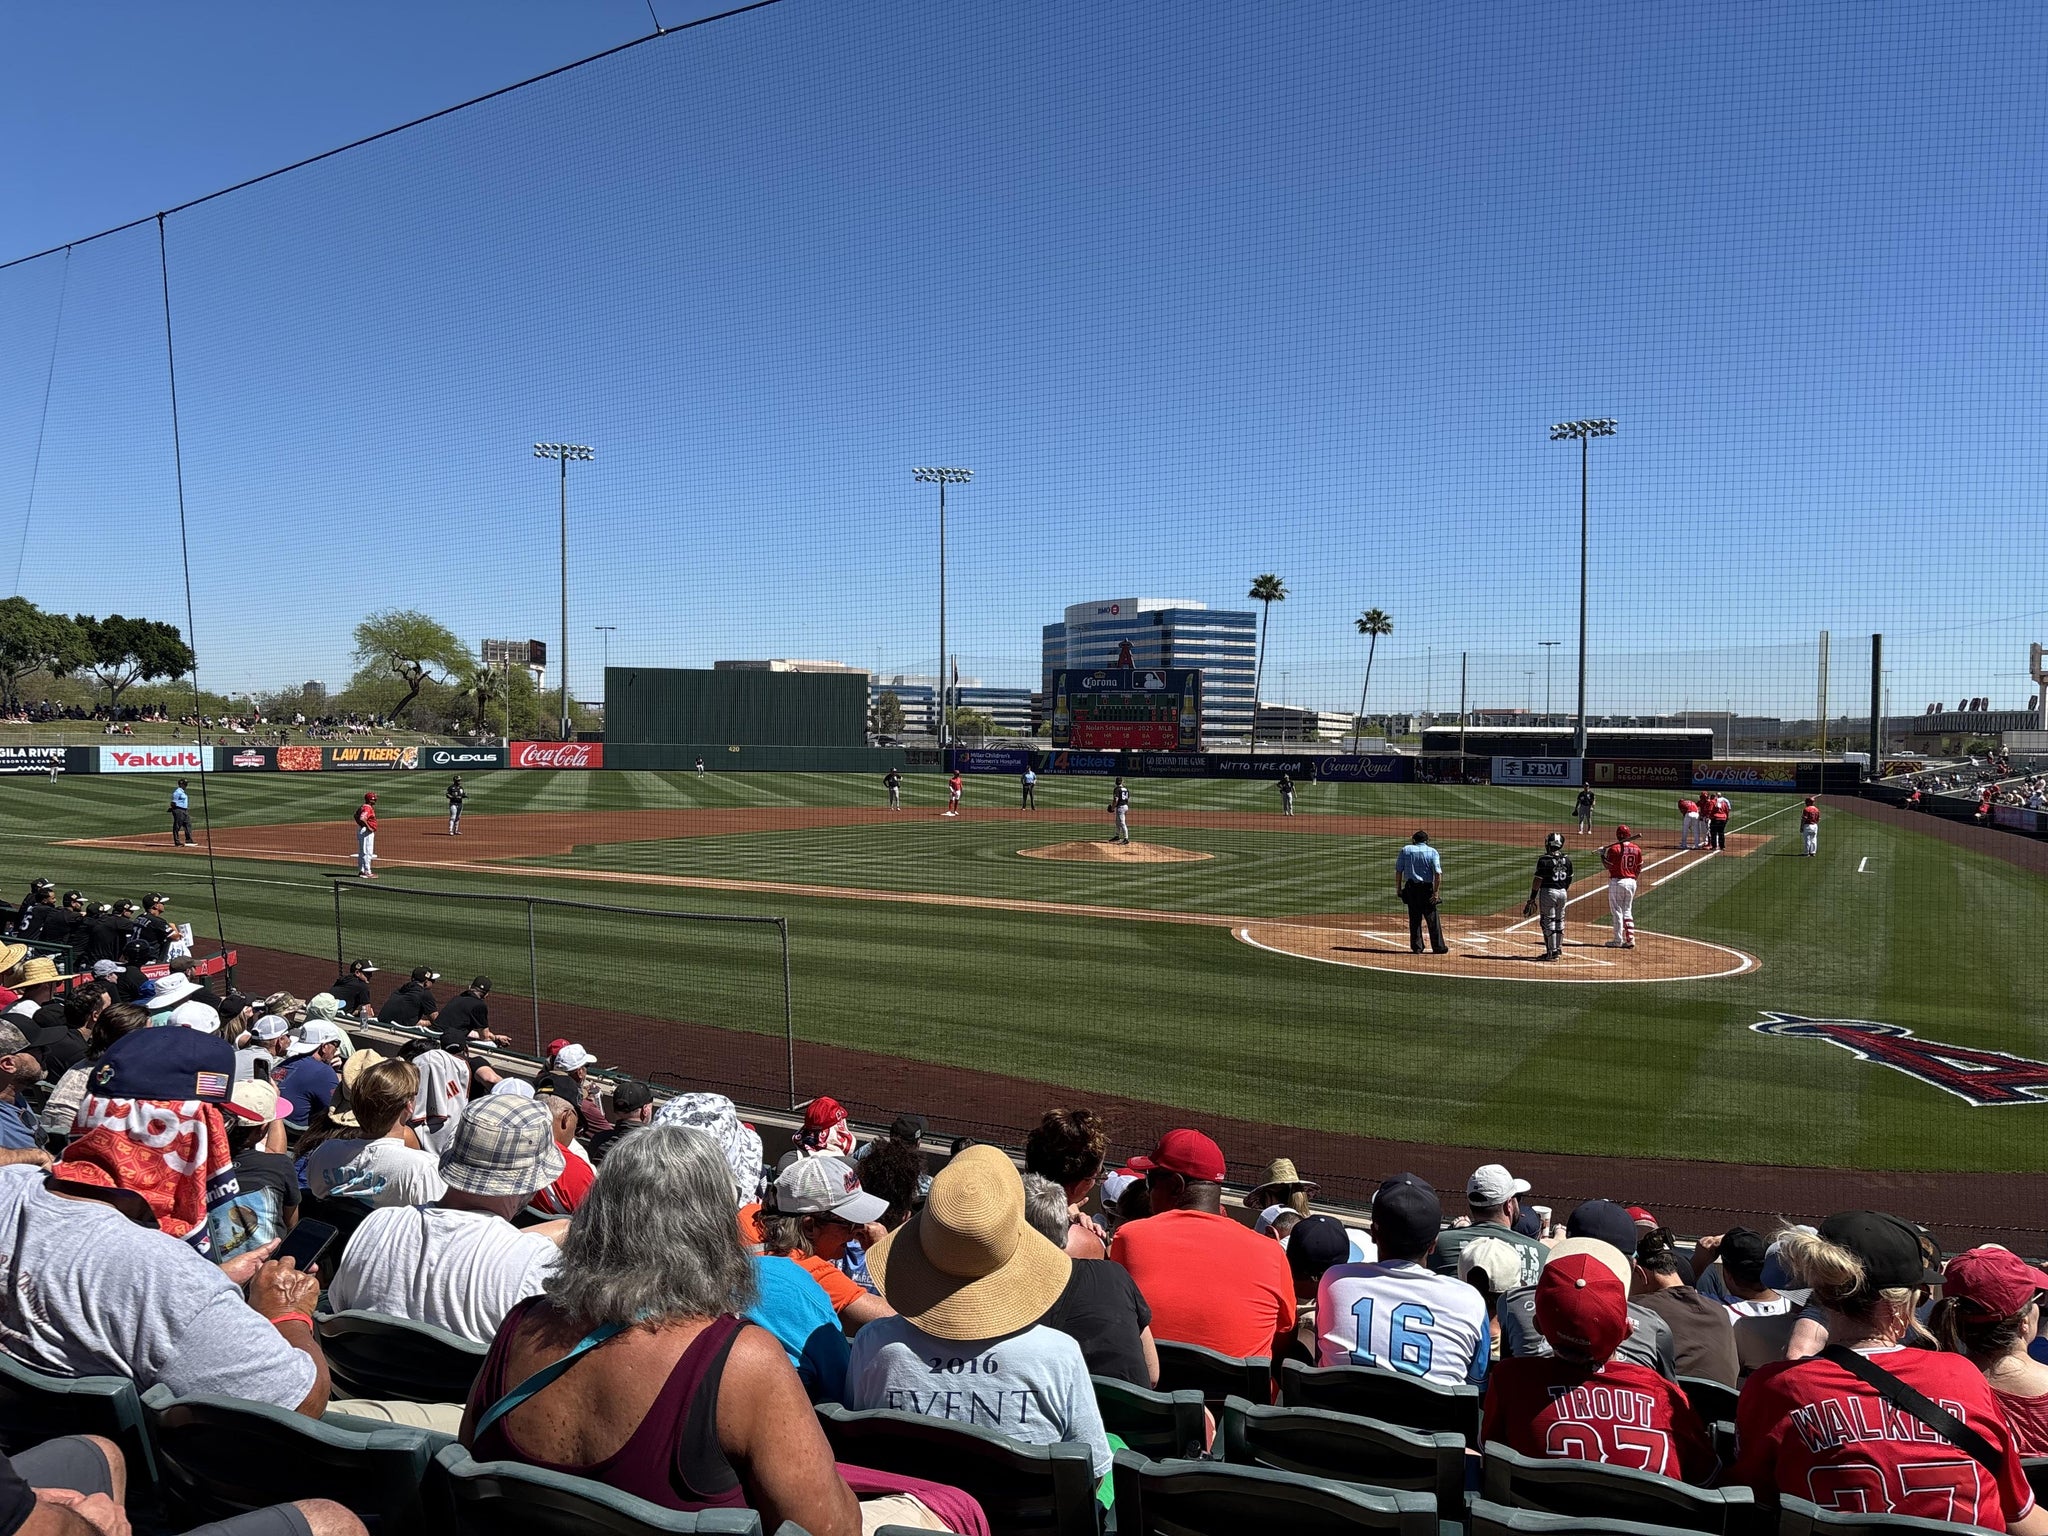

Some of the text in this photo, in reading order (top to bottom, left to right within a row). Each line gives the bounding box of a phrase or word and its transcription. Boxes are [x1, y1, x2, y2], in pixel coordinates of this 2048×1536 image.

[1082, 677, 1117, 689] Corona
[29, 748, 65, 758] RIVER
[111, 752, 202, 767] Yakult
[332, 748, 401, 761] LAW TIGERS
[450, 754, 497, 762] LEXUS
[520, 743, 592, 767] Coca-Cola
[1220, 762, 1301, 772] NITTO TIRE.COM
[1320, 757, 1396, 777] Crown Royal
[1526, 763, 1563, 775] FBM
[1617, 766, 1678, 775] PECHANGA
[1693, 763, 1758, 783] Surfside
[1622, 854, 1636, 869] 18
[1350, 1296, 1435, 1378] 16
[928, 1352, 999, 1375] 2016
[887, 1390, 1039, 1425] EVENT
[1547, 1386, 1655, 1428] TROUT
